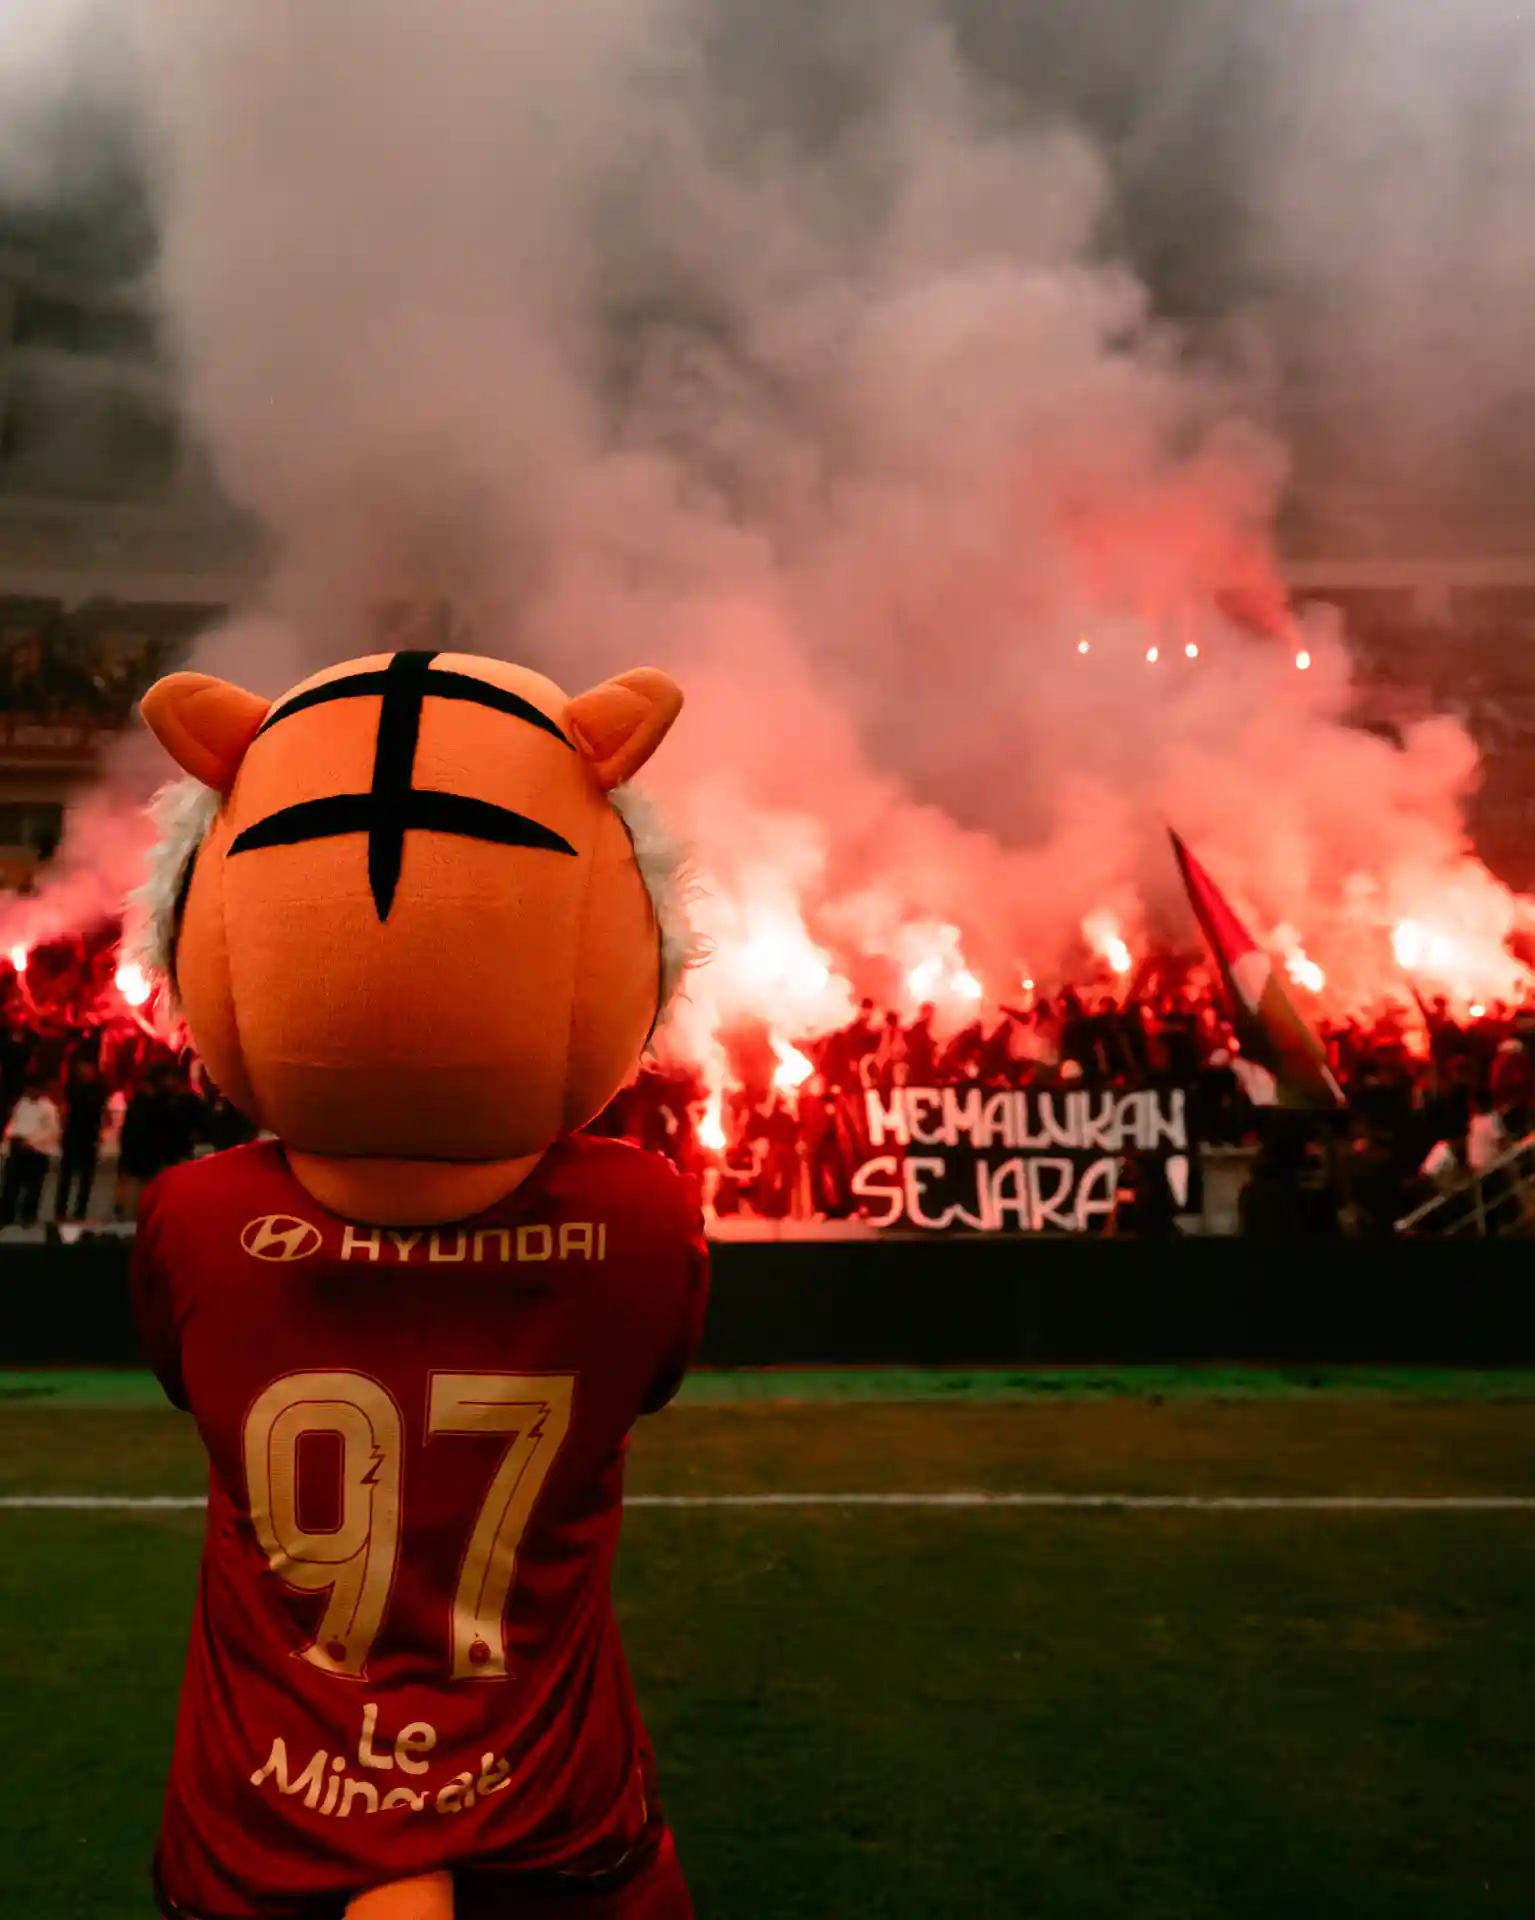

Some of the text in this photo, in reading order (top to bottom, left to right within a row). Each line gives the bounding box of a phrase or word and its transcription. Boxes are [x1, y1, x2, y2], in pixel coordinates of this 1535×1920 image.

[864, 1087, 1188, 1151] MEMALUKAN
[340, 1221, 606, 1262] HYUNDAI
[241, 1368, 579, 1682] 97
[358, 1703, 437, 1775] Le
